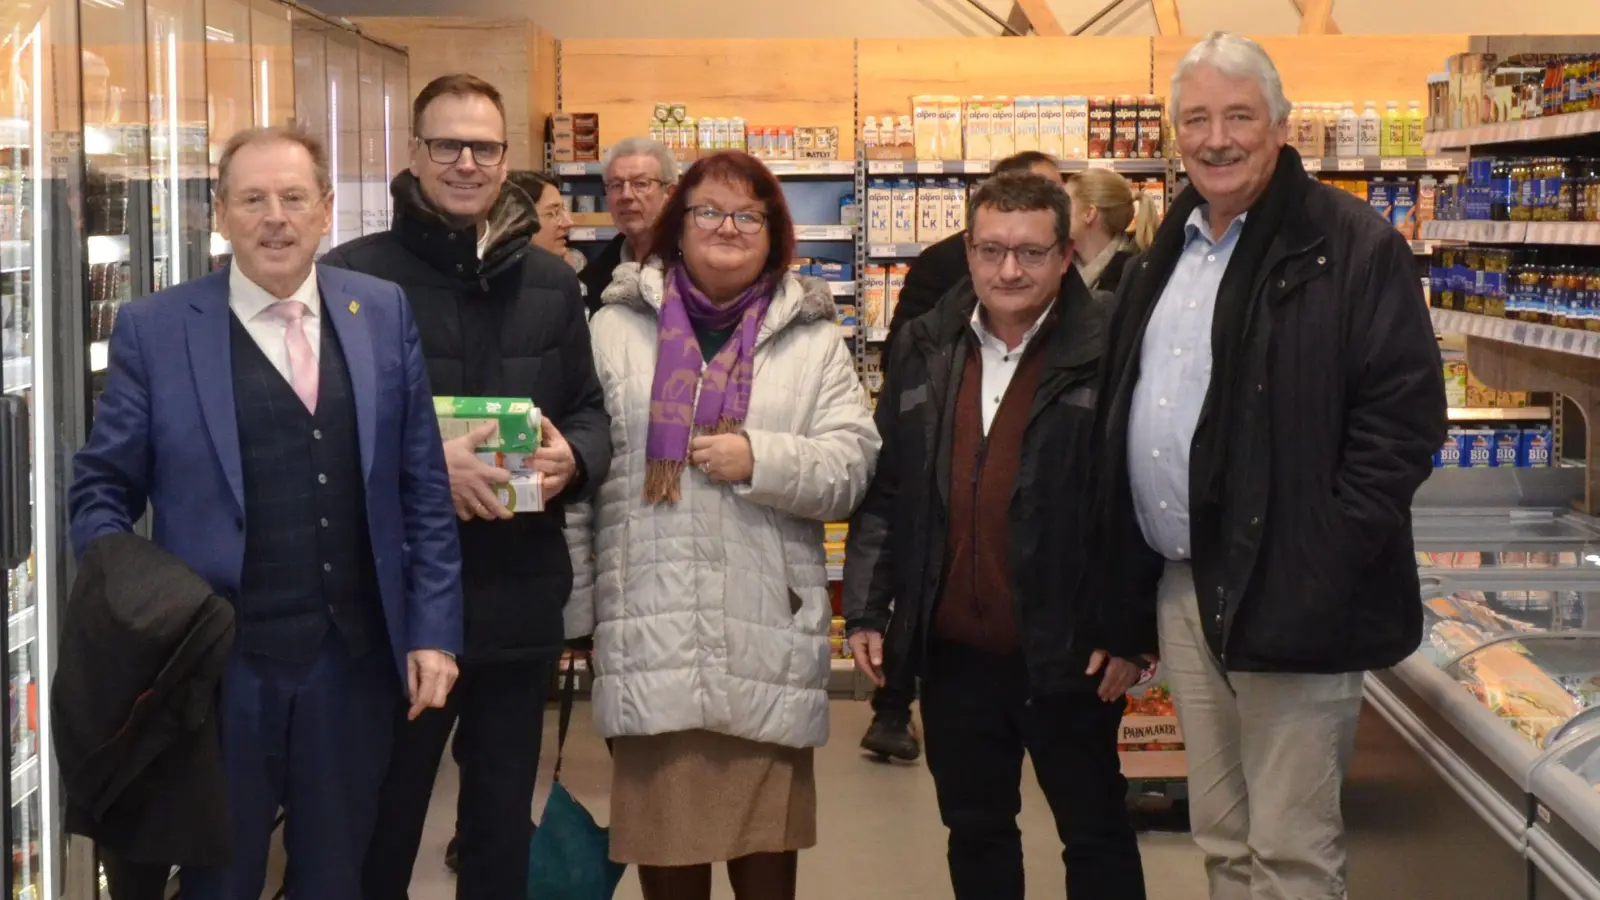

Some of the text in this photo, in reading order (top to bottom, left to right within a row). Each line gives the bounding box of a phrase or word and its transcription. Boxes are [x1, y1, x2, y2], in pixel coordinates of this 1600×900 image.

[916, 110, 937, 120] alpro
[939, 110, 956, 120] alpr
[969, 110, 989, 120] alpro
[992, 110, 1013, 120] alpro
[1016, 109, 1037, 120] alpro
[1041, 109, 1061, 120] alpro
[1065, 109, 1086, 120] alpro
[1090, 108, 1112, 119] alpro
[1115, 108, 1137, 119] alpro
[1139, 108, 1161, 119] alpro
[869, 192, 890, 202] alpro
[893, 192, 914, 202] alpo
[920, 192, 940, 202] alpro
[944, 192, 964, 202] alpo
[864, 279, 883, 287] alpro
[1441, 449, 1460, 460] BIO
[1470, 449, 1490, 460] BIO
[1496, 448, 1516, 459] BIO
[1528, 449, 1548, 460] BIO
[1123, 723, 1176, 740] PAINMAKER
